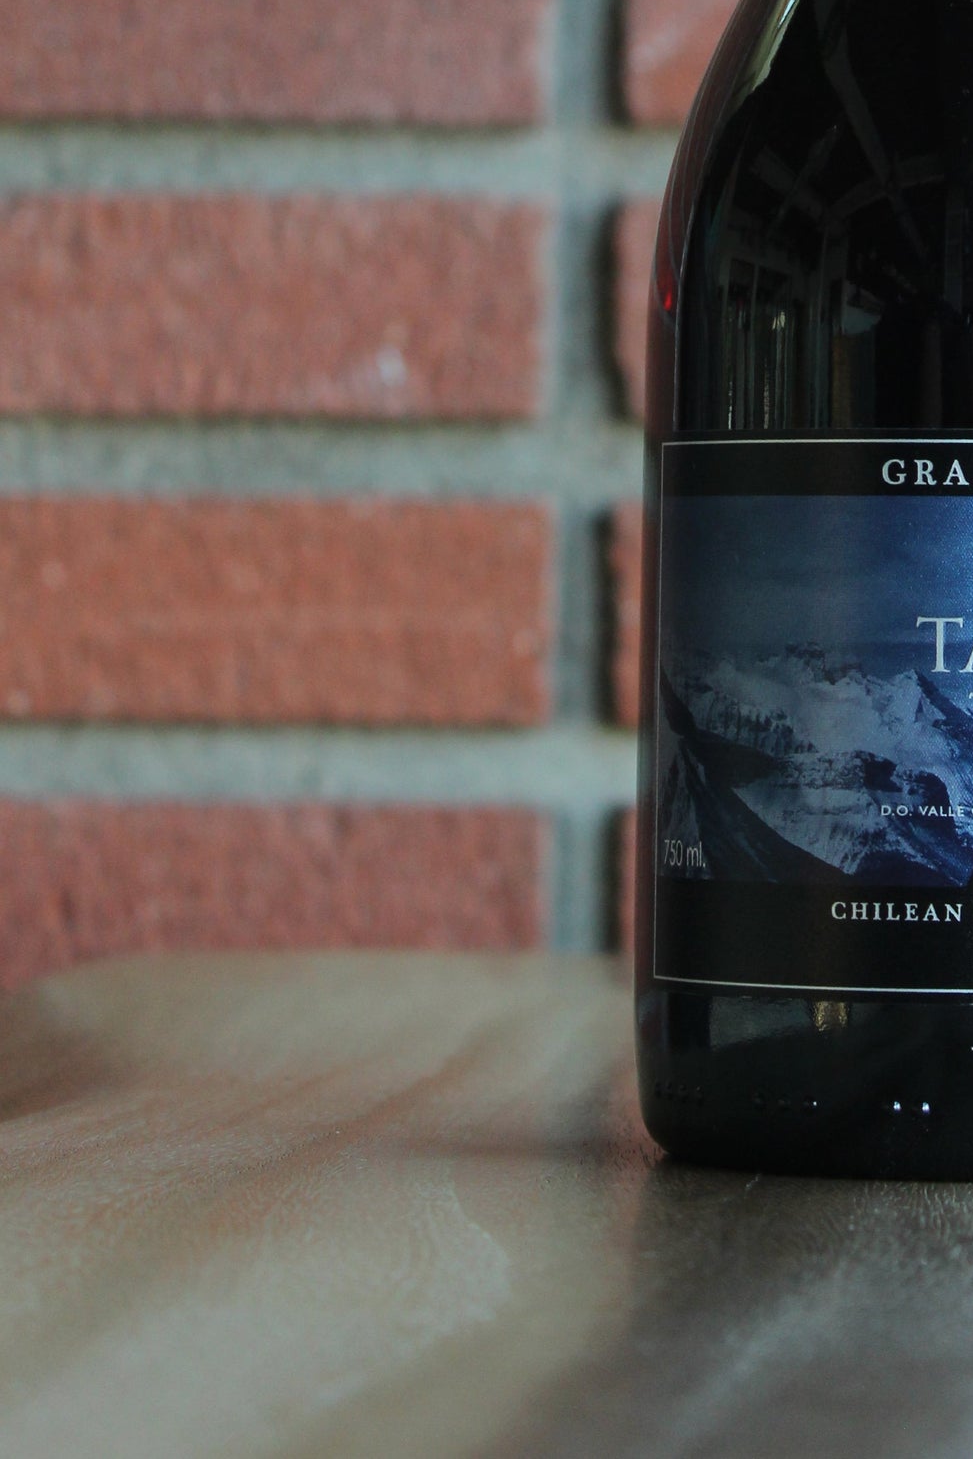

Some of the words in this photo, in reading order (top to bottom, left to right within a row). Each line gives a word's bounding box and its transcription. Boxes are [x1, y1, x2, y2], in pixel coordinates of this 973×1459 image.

[880, 805, 912, 816] D.O.
[919, 805, 965, 817] VALLE
[664, 839, 683, 866] 750
[831, 901, 963, 922] CHILEAN
